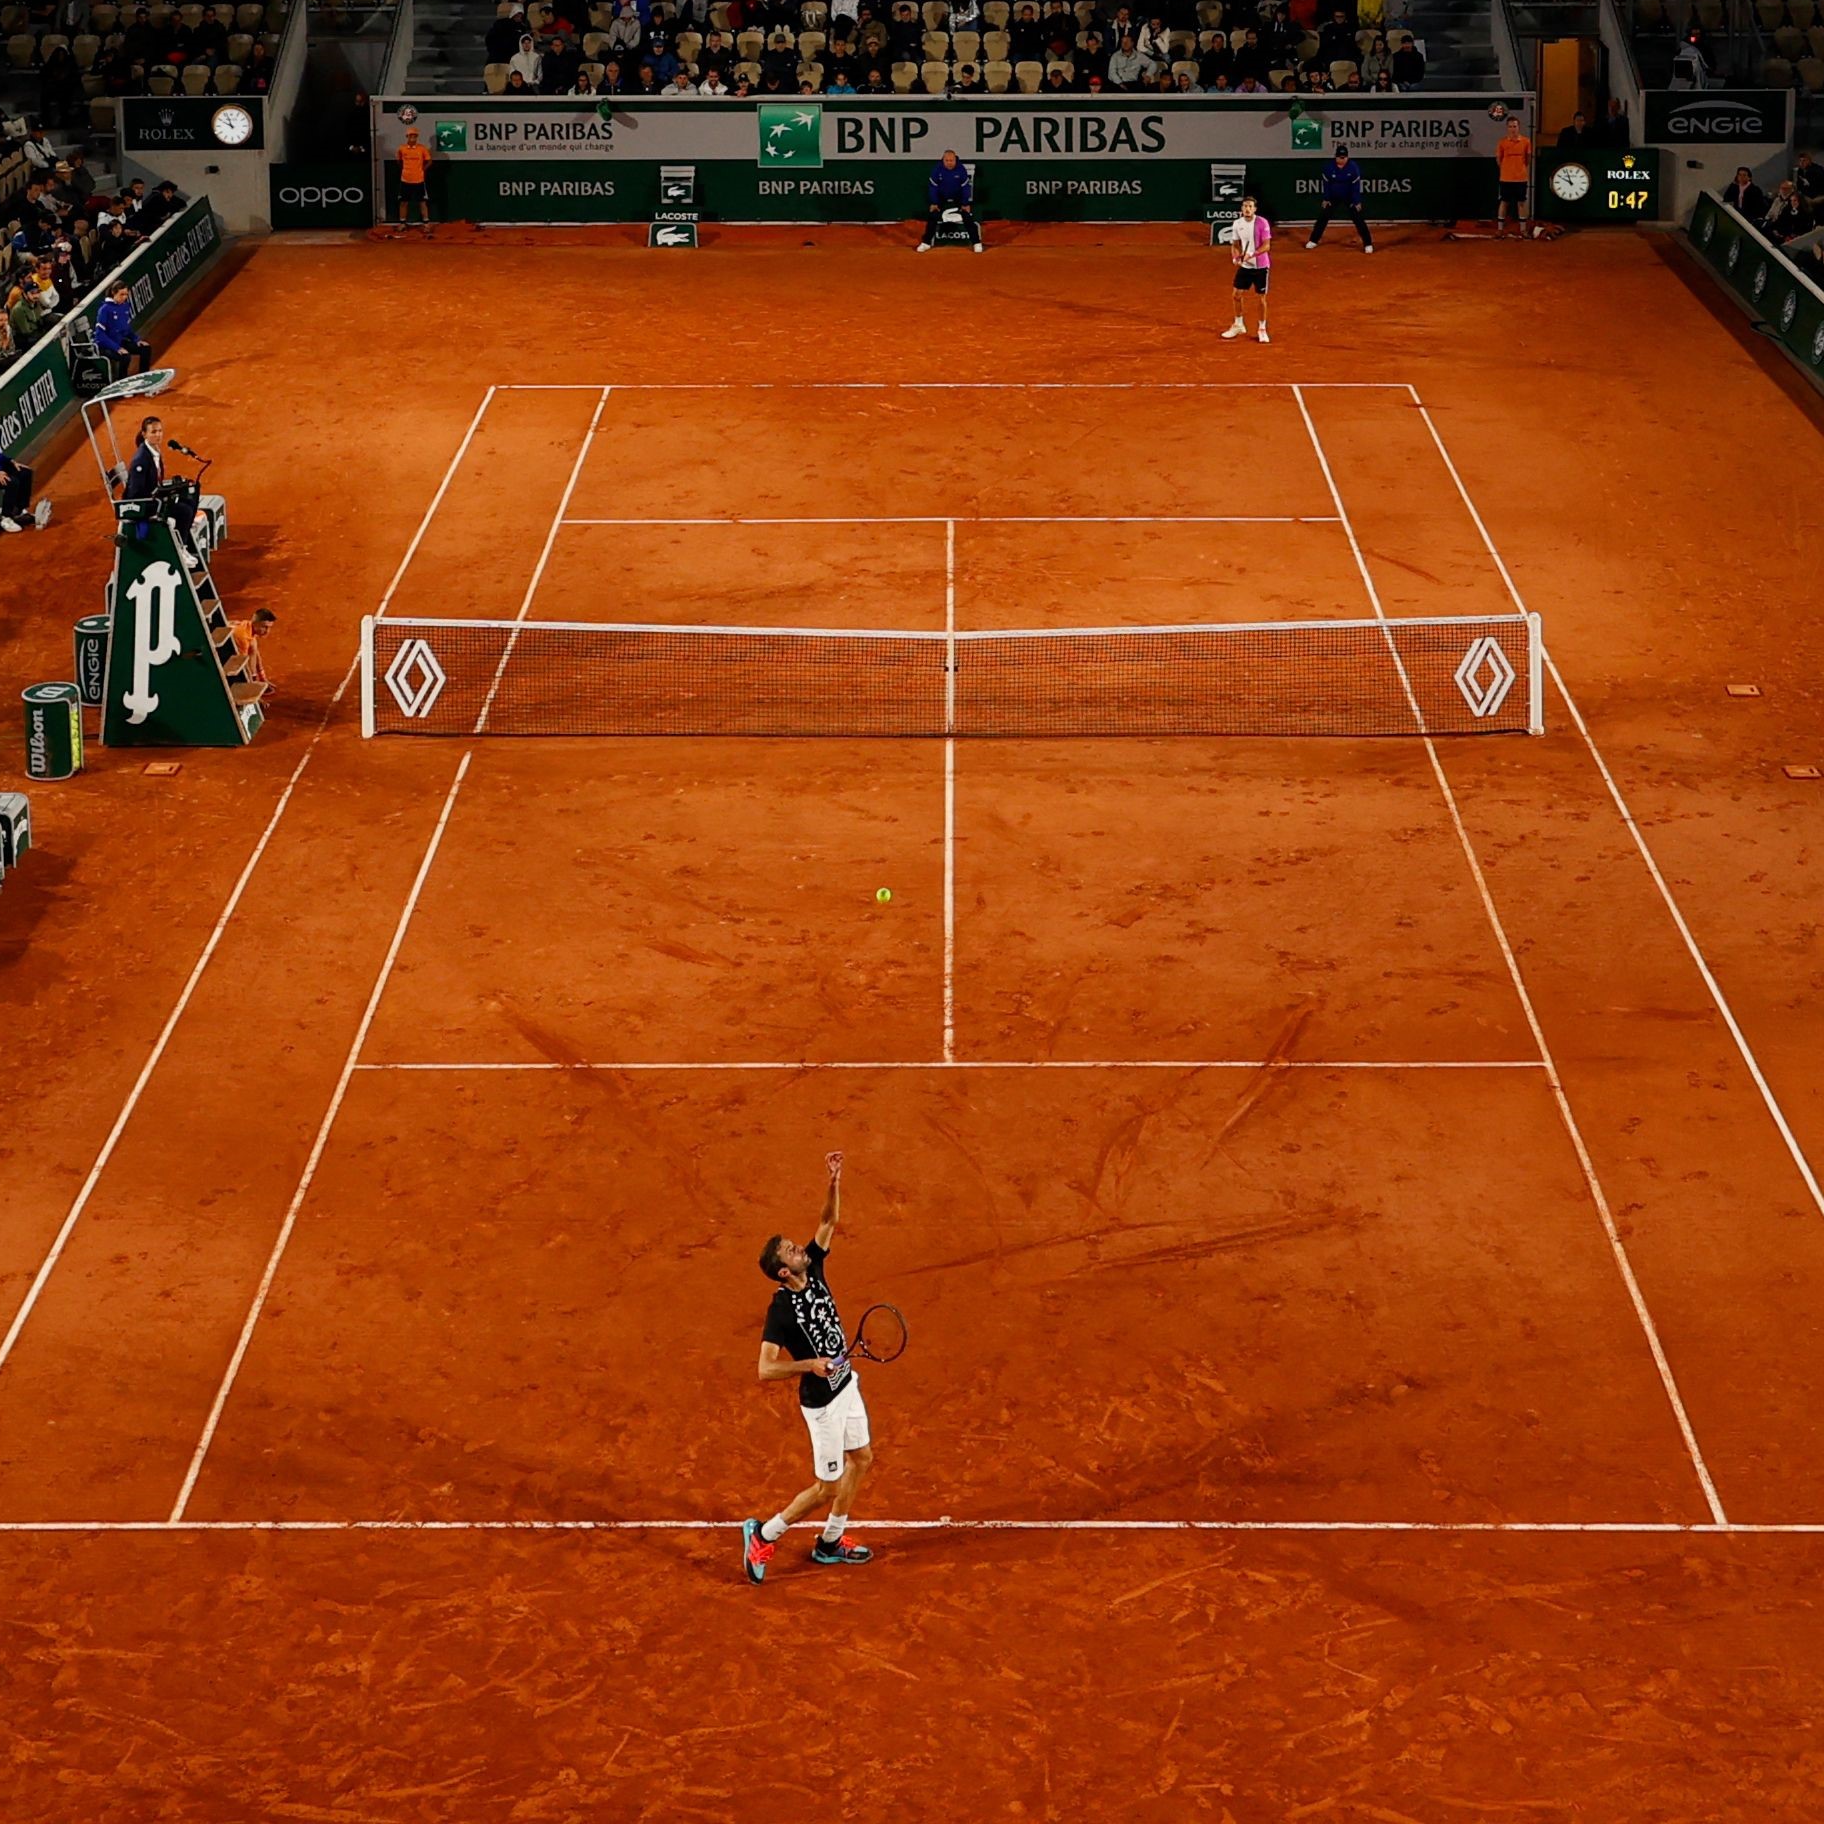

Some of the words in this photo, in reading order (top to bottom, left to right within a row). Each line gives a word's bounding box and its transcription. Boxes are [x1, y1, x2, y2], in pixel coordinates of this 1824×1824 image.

[138, 128, 196, 140] ROLEX
[474, 123, 518, 141] BNP
[524, 122, 613, 141] PARIBAS
[836, 117, 929, 154] BNP
[975, 115, 1167, 154] PARIBAS
[1330, 120, 1375, 138] BNP
[1380, 119, 1470, 138] PARIBAS
[485, 142, 517, 152] banque
[519, 142, 537, 151] d'un
[539, 142, 567, 151] monde
[569, 143, 583, 152] qui
[585, 142, 615, 152] change
[1350, 140, 1371, 149] bank
[1374, 140, 1388, 150] for
[1399, 140, 1440, 150] changing
[1442, 139, 1469, 149] world
[1607, 170, 1651, 180] ROLEX
[499, 181, 536, 196] BNP
[540, 181, 616, 196] PARIBAS
[758, 180, 795, 195] BNP
[799, 180, 875, 195] PARIBAS
[1026, 180, 1062, 195] BNP
[1066, 180, 1142, 195] PARIBAS
[1359, 178, 1413, 193] RIBAS
[278, 186, 365, 209] oppo
[1607, 190, 1650, 210] 0:47
[654, 211, 700, 222] LACOSTE
[1206, 210, 1243, 219] LACOST
[30, 706, 47, 774] Wilson
